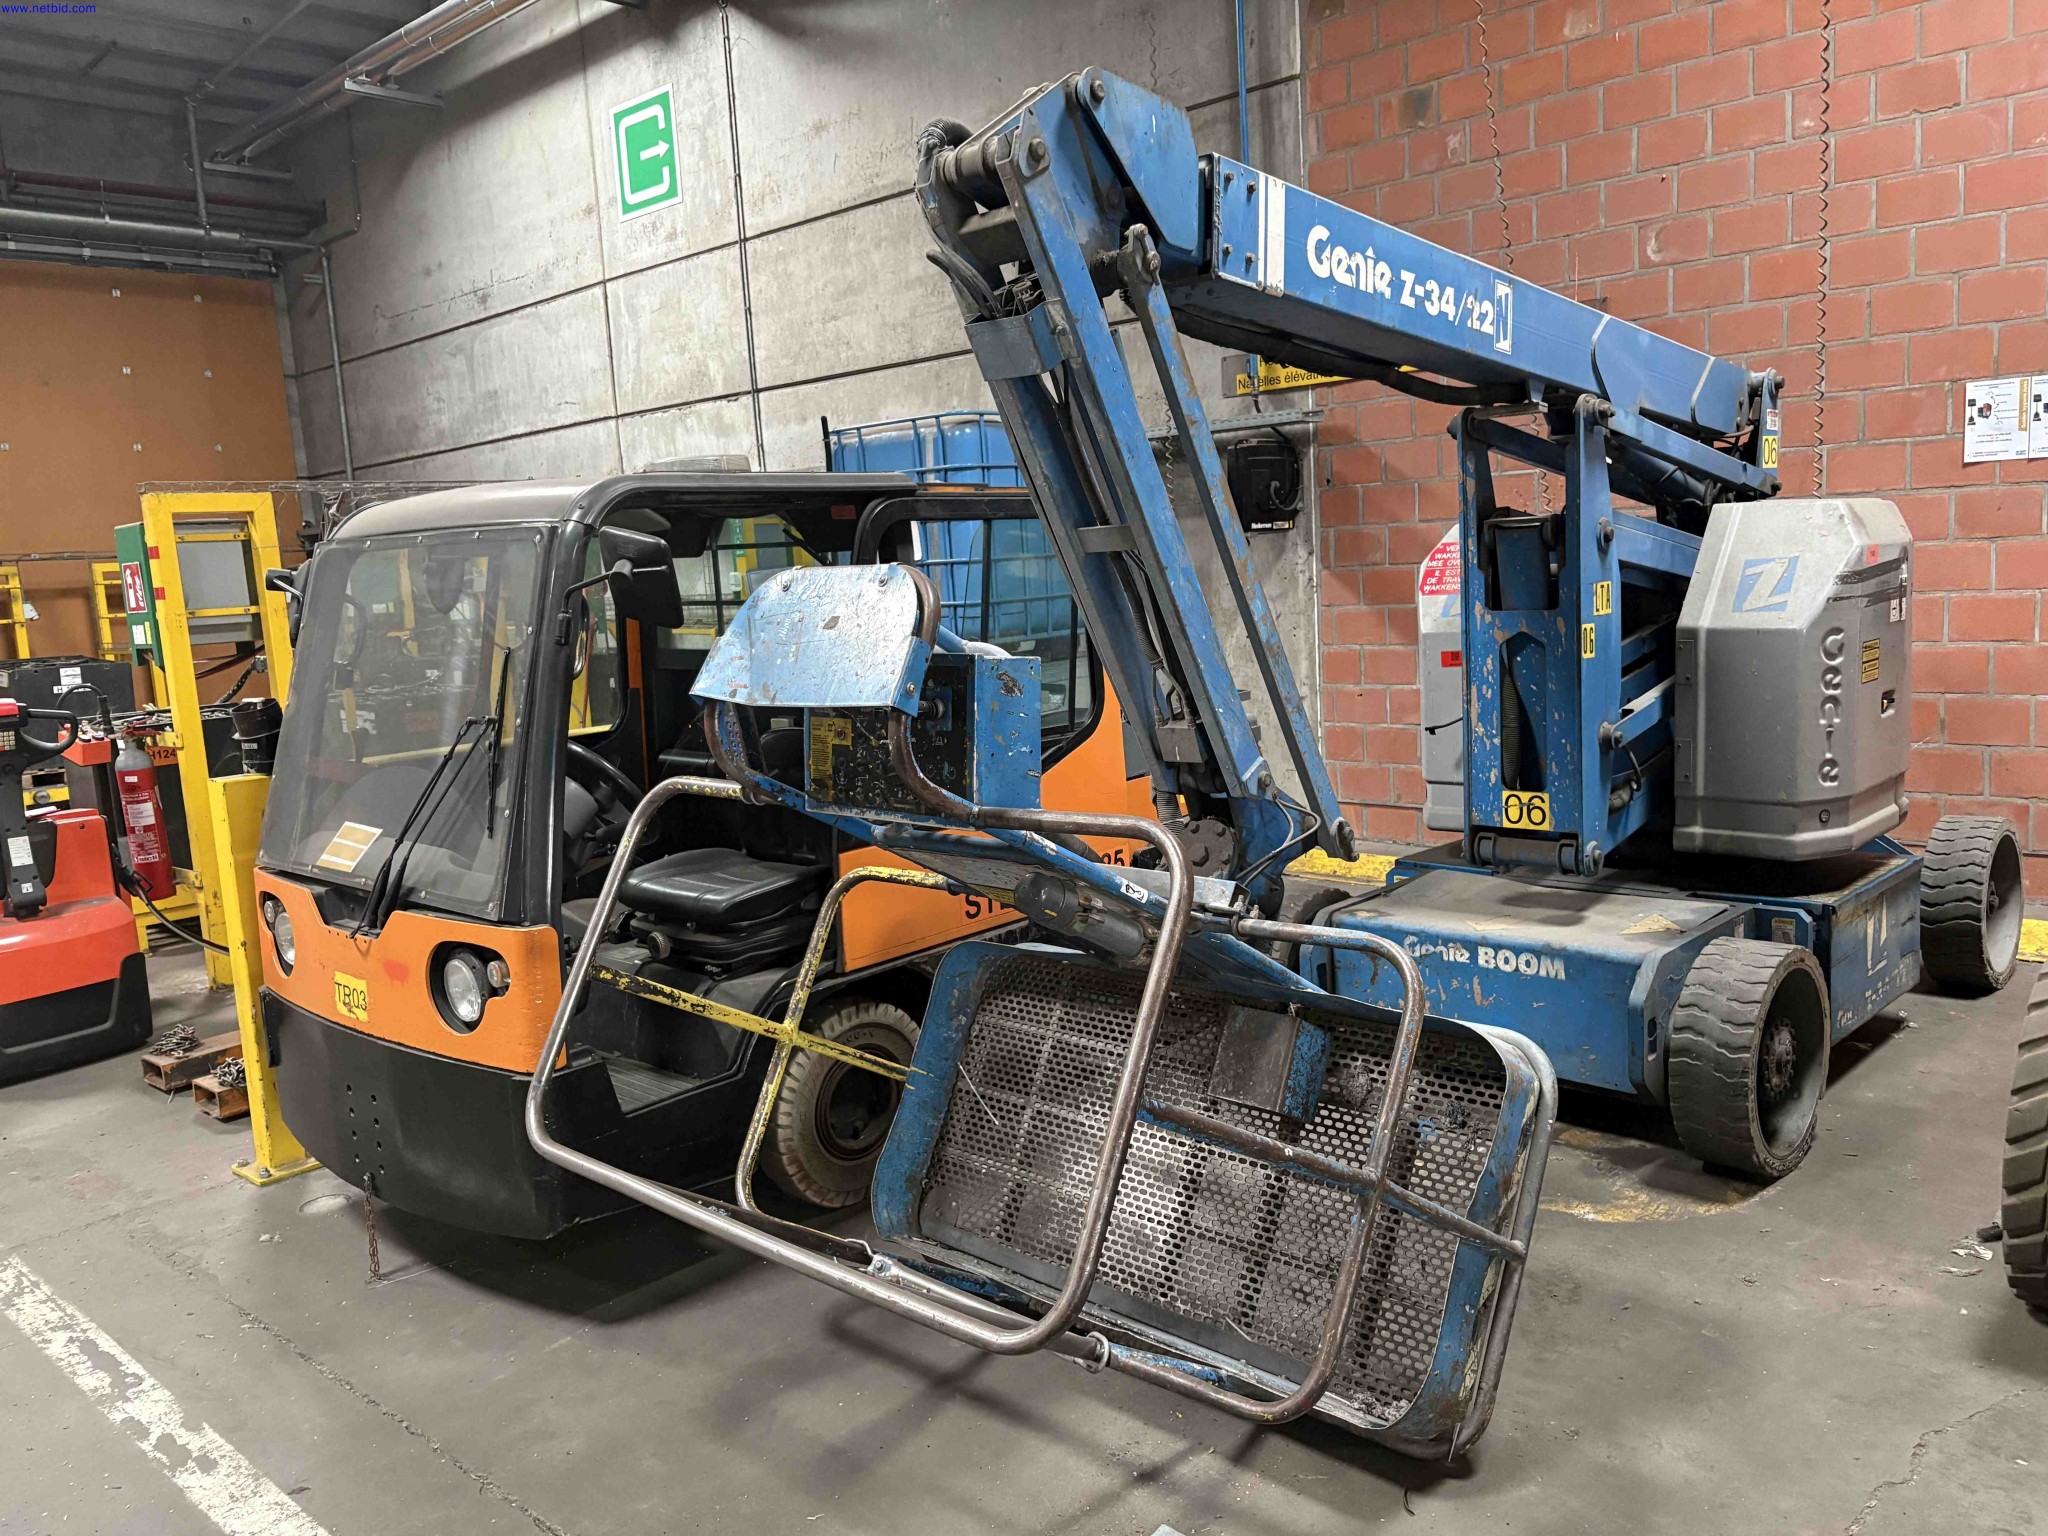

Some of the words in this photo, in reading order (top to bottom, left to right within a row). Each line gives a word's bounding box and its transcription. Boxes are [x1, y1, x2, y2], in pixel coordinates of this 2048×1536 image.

[1306, 224, 1396, 299] Genie
[1400, 269, 1495, 336] Z-34/22
[1238, 375, 1281, 390] Naelles
[1763, 437, 1778, 465] 06
[1595, 583, 1611, 613] LTA
[1582, 626, 1594, 654] 06
[1817, 626, 1846, 787] Genie
[1504, 793, 1547, 826] 06
[1403, 934, 1471, 963] Genie
[1477, 945, 1566, 981] BOOM
[333, 981, 368, 1011] TR03
